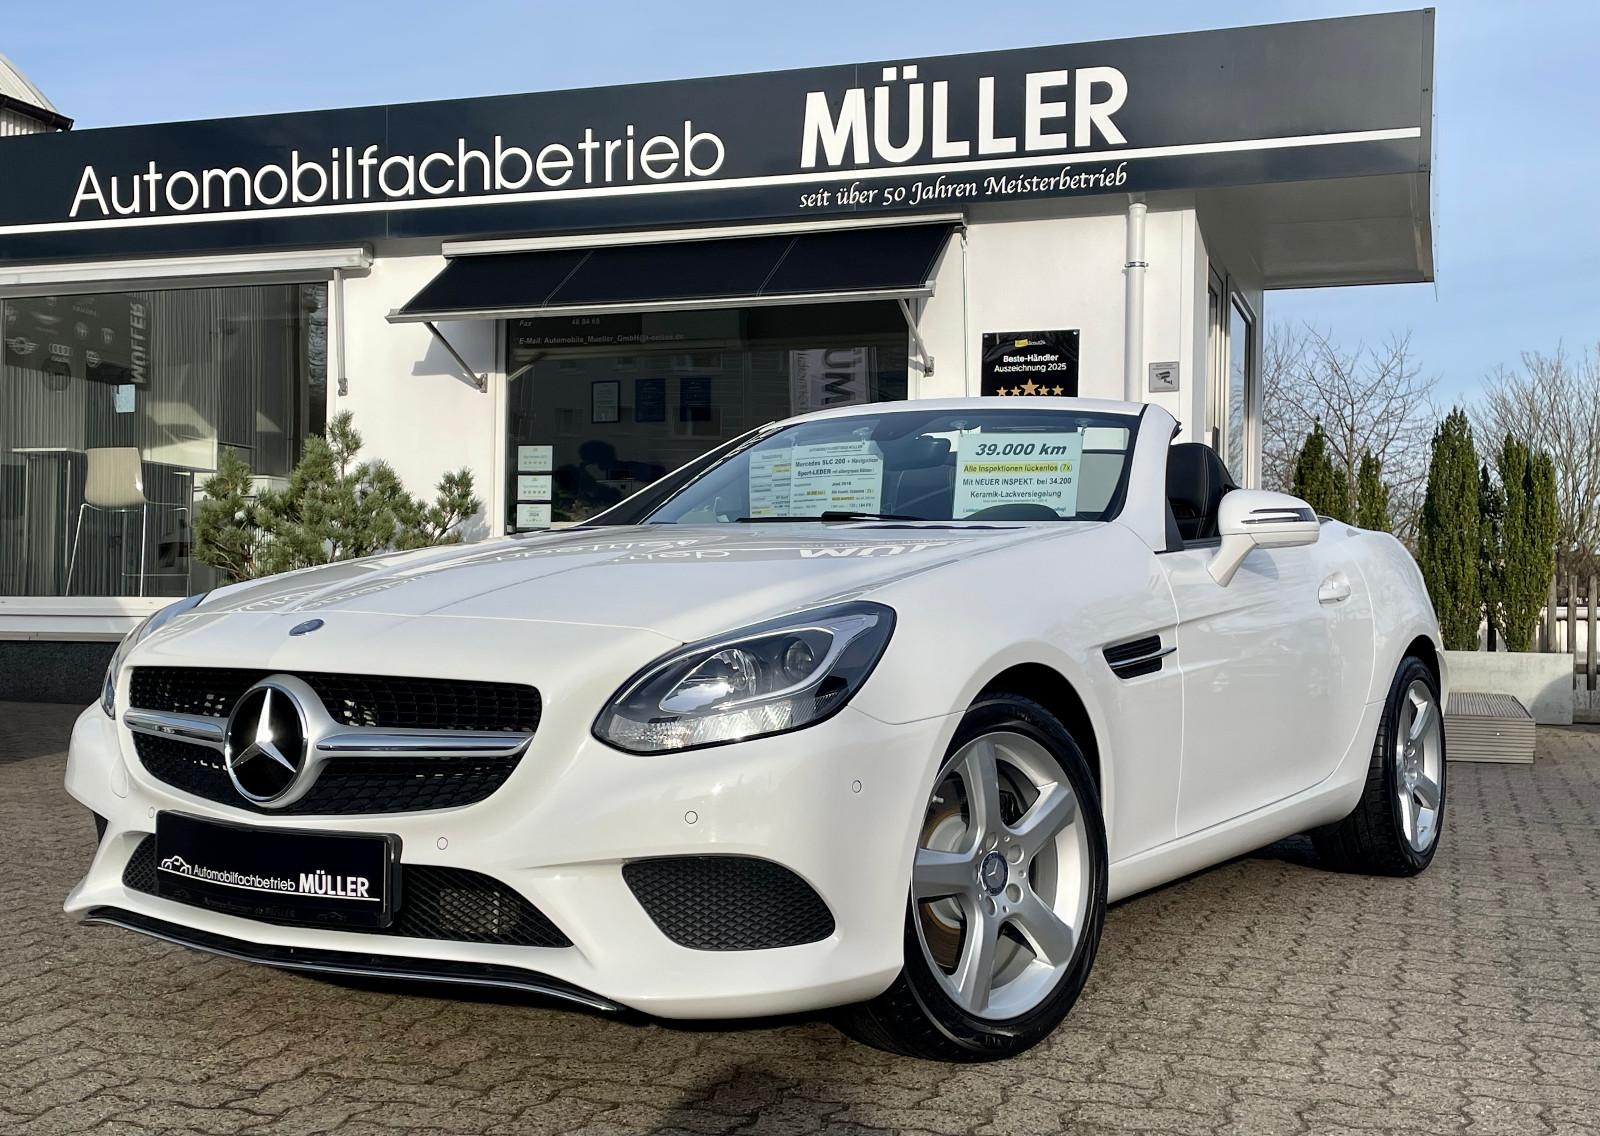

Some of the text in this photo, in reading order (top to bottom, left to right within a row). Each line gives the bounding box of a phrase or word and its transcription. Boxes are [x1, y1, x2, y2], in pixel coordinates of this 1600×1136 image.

[69, 64, 1128, 218] Automobilfachbetrieb MÜLLER
[800, 161, 1128, 208] seit über 50 Jahren Meisterbetrieb
[1003, 353, 1059, 364] Beste-Händler
[994, 362, 1067, 374] Auszeichnung 2025
[975, 443, 1067, 456] 39.000 km
[963, 463, 1073, 474] Alle Inspektionen lückenlos (7x)
[962, 478, 974, 486] Mit
[975, 478, 999, 486] NEUER
[1036, 477, 1048, 485] bei
[1049, 477, 1072, 485] 34.200
[970, 490, 1062, 499] Keramik-Lackversiegelung
[193, 864, 370, 898] Automobilfachbetrieb MÜLLER
